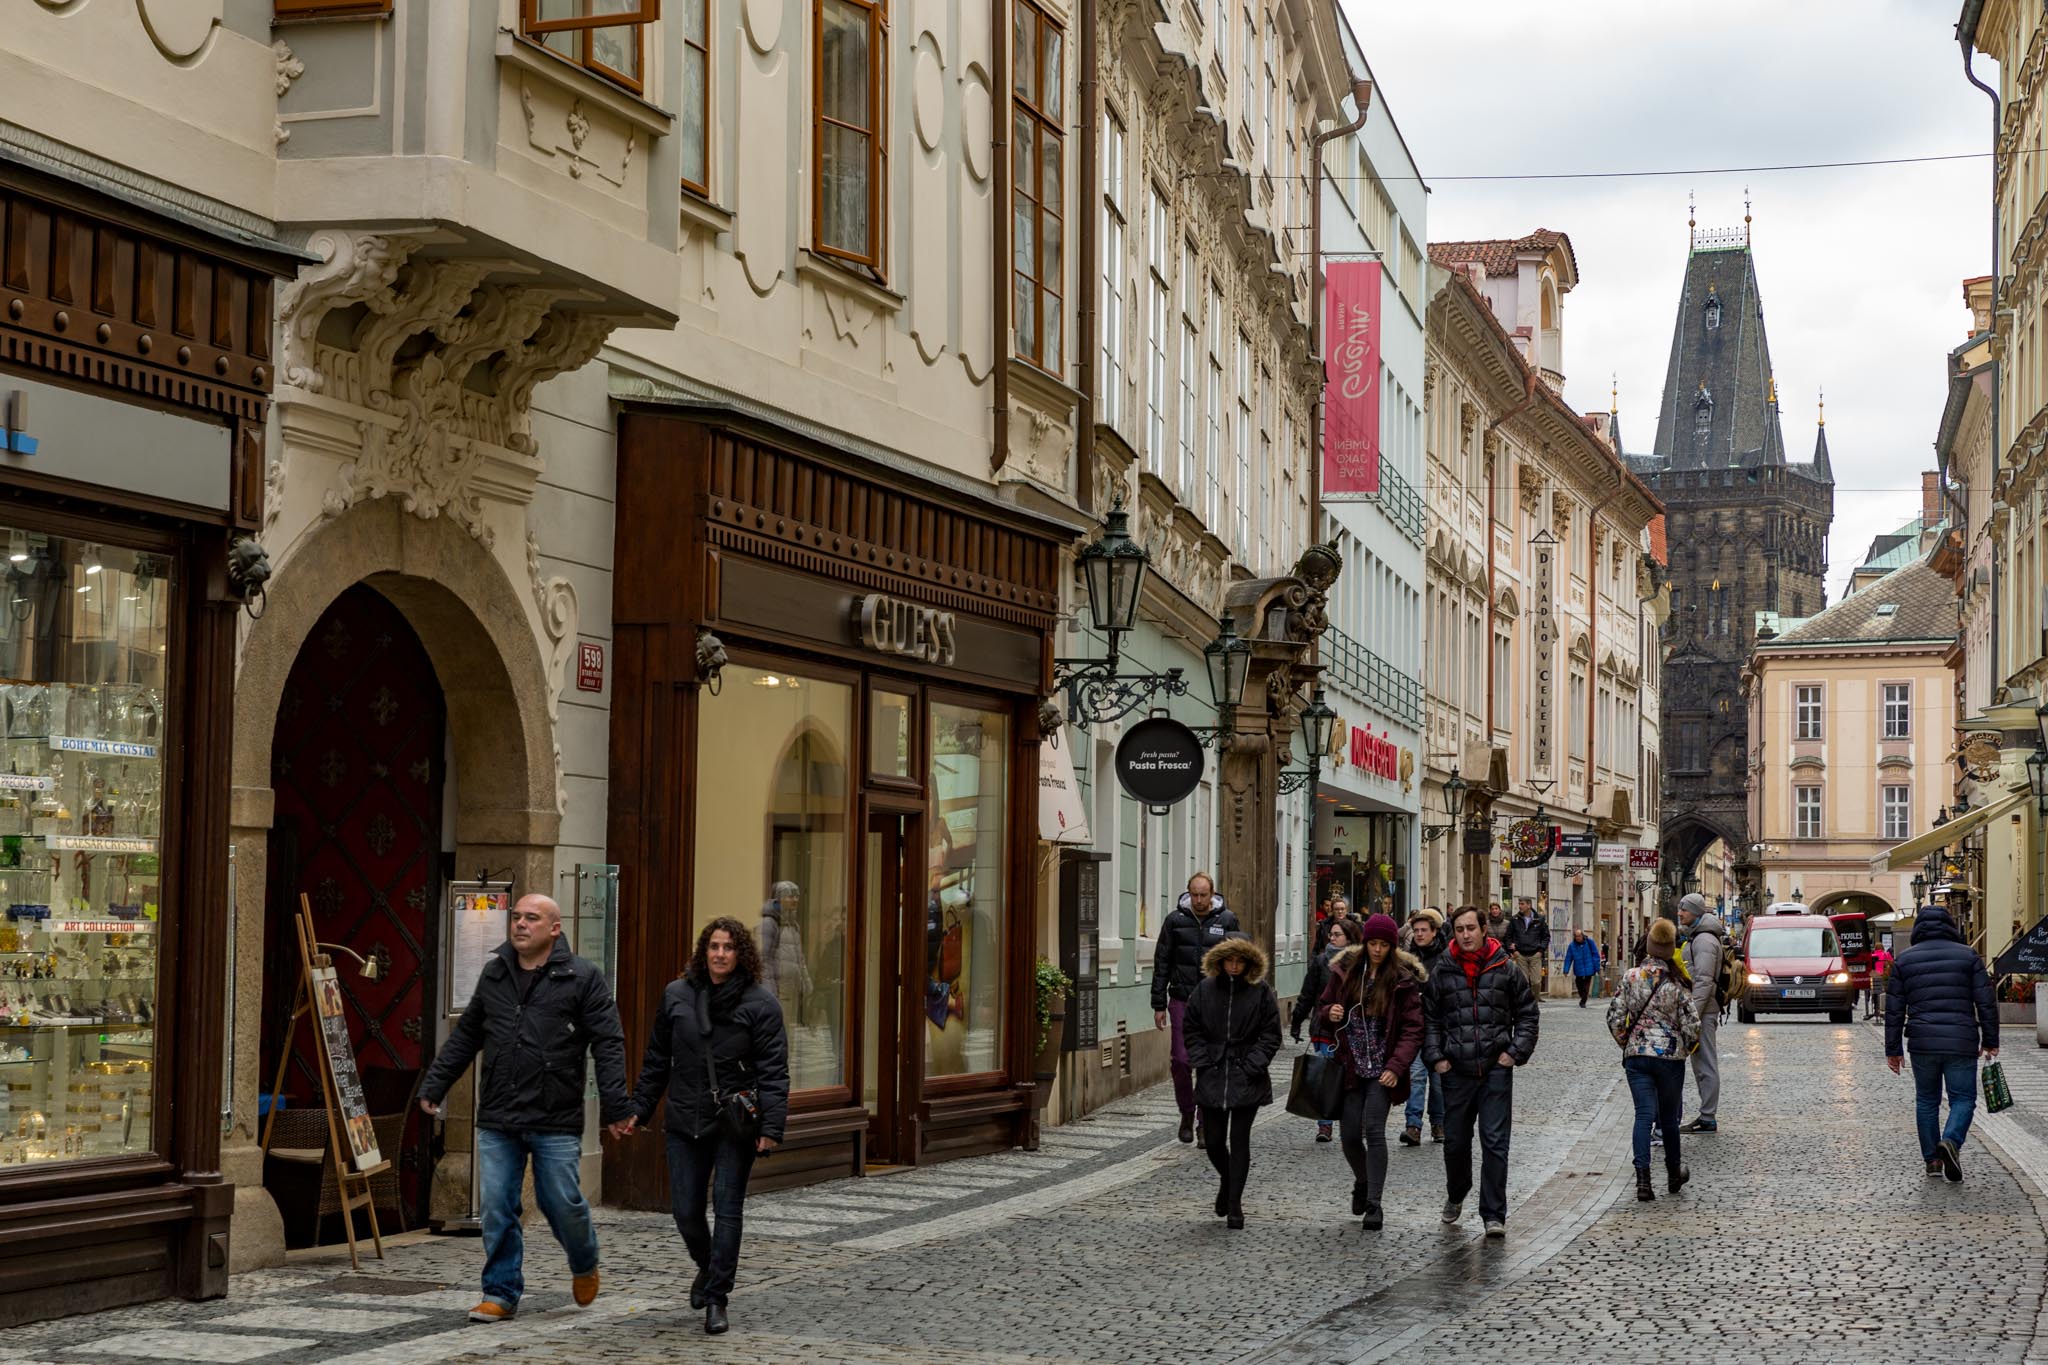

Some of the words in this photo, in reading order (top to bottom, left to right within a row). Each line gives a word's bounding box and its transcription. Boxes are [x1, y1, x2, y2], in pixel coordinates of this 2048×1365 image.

[1539, 552, 1548, 642] DIVADLO
[861, 593, 956, 666] GUESS
[584, 648, 602, 669] 598
[62, 738, 110, 753] BOHEMIA
[112, 743, 156, 757] CRYSTAL
[1140, 751, 1157, 760] fresh
[1129, 761, 1156, 770] Pasta
[105, 839, 143, 851] CRYSTAL
[64, 922, 80, 931] ART
[84, 922, 135, 932] COLLECTION
